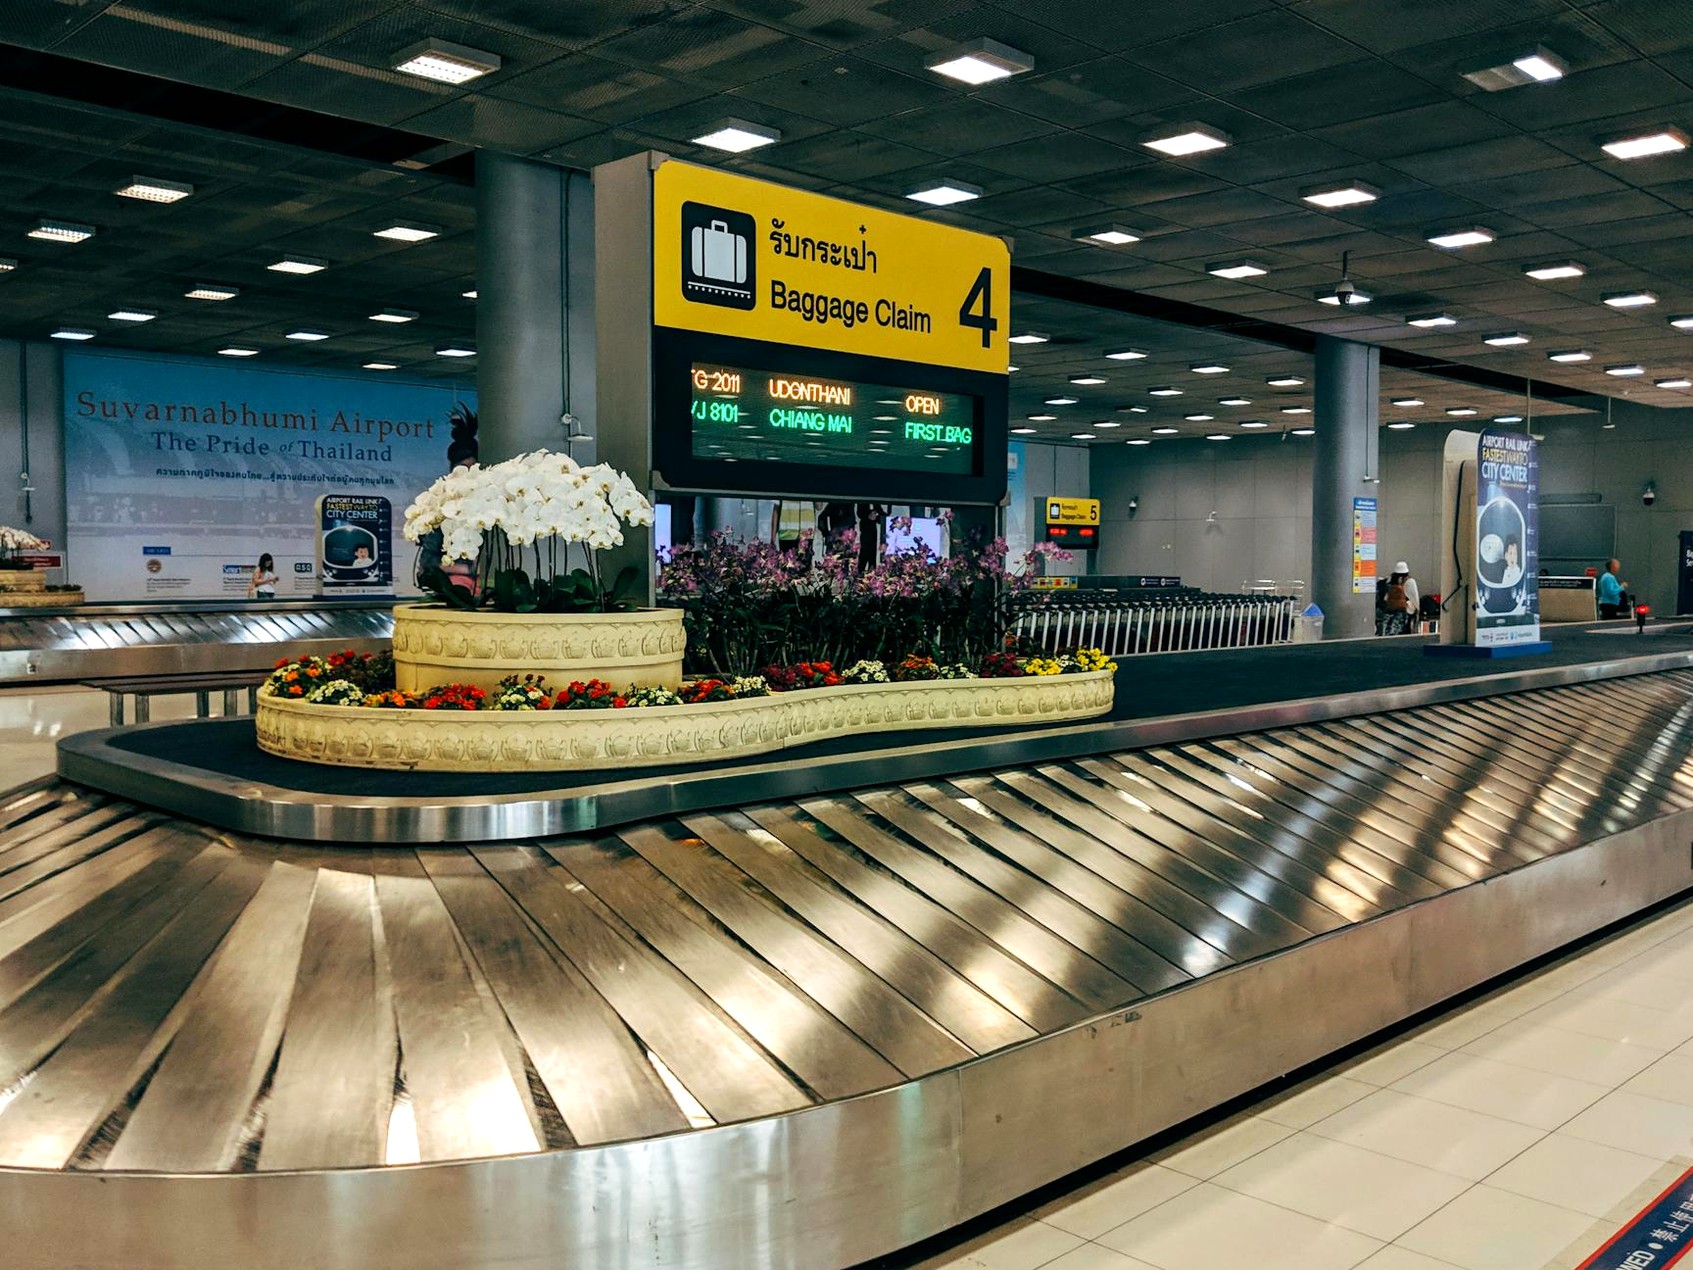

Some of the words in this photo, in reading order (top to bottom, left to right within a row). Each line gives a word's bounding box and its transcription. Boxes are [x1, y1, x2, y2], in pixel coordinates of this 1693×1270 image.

[769, 218, 877, 274] รับกระเป๋า
[771, 279, 868, 328] Baggage
[875, 299, 931, 334] Claim
[959, 266, 998, 349] 4
[712, 371, 740, 394] 2011
[768, 378, 851, 406] UDONTHANI
[905, 395, 940, 415] OPEN
[76, 391, 319, 431] Suvarnabhumi
[330, 409, 434, 443] Airport
[710, 401, 738, 423] 8101
[769, 408, 826, 432] CHIANG
[828, 414, 853, 434] MAI
[905, 421, 944, 441] FIRST
[945, 425, 973, 444] BAG
[152, 431, 197, 452] The
[206, 434, 270, 456] Pride
[279, 440, 295, 453] of
[298, 440, 393, 462] Thailand
[1482, 435, 1505, 448] AIRPORT
[1505, 438, 1516, 450] RAIL
[1483, 448, 1507, 462] FASTEST
[1482, 462, 1500, 479] CITY
[1500, 464, 1528, 482] CENTER
[326, 510, 346, 518] CITY
[346, 510, 378, 519] CENTER
[1090, 504, 1098, 521] 5
